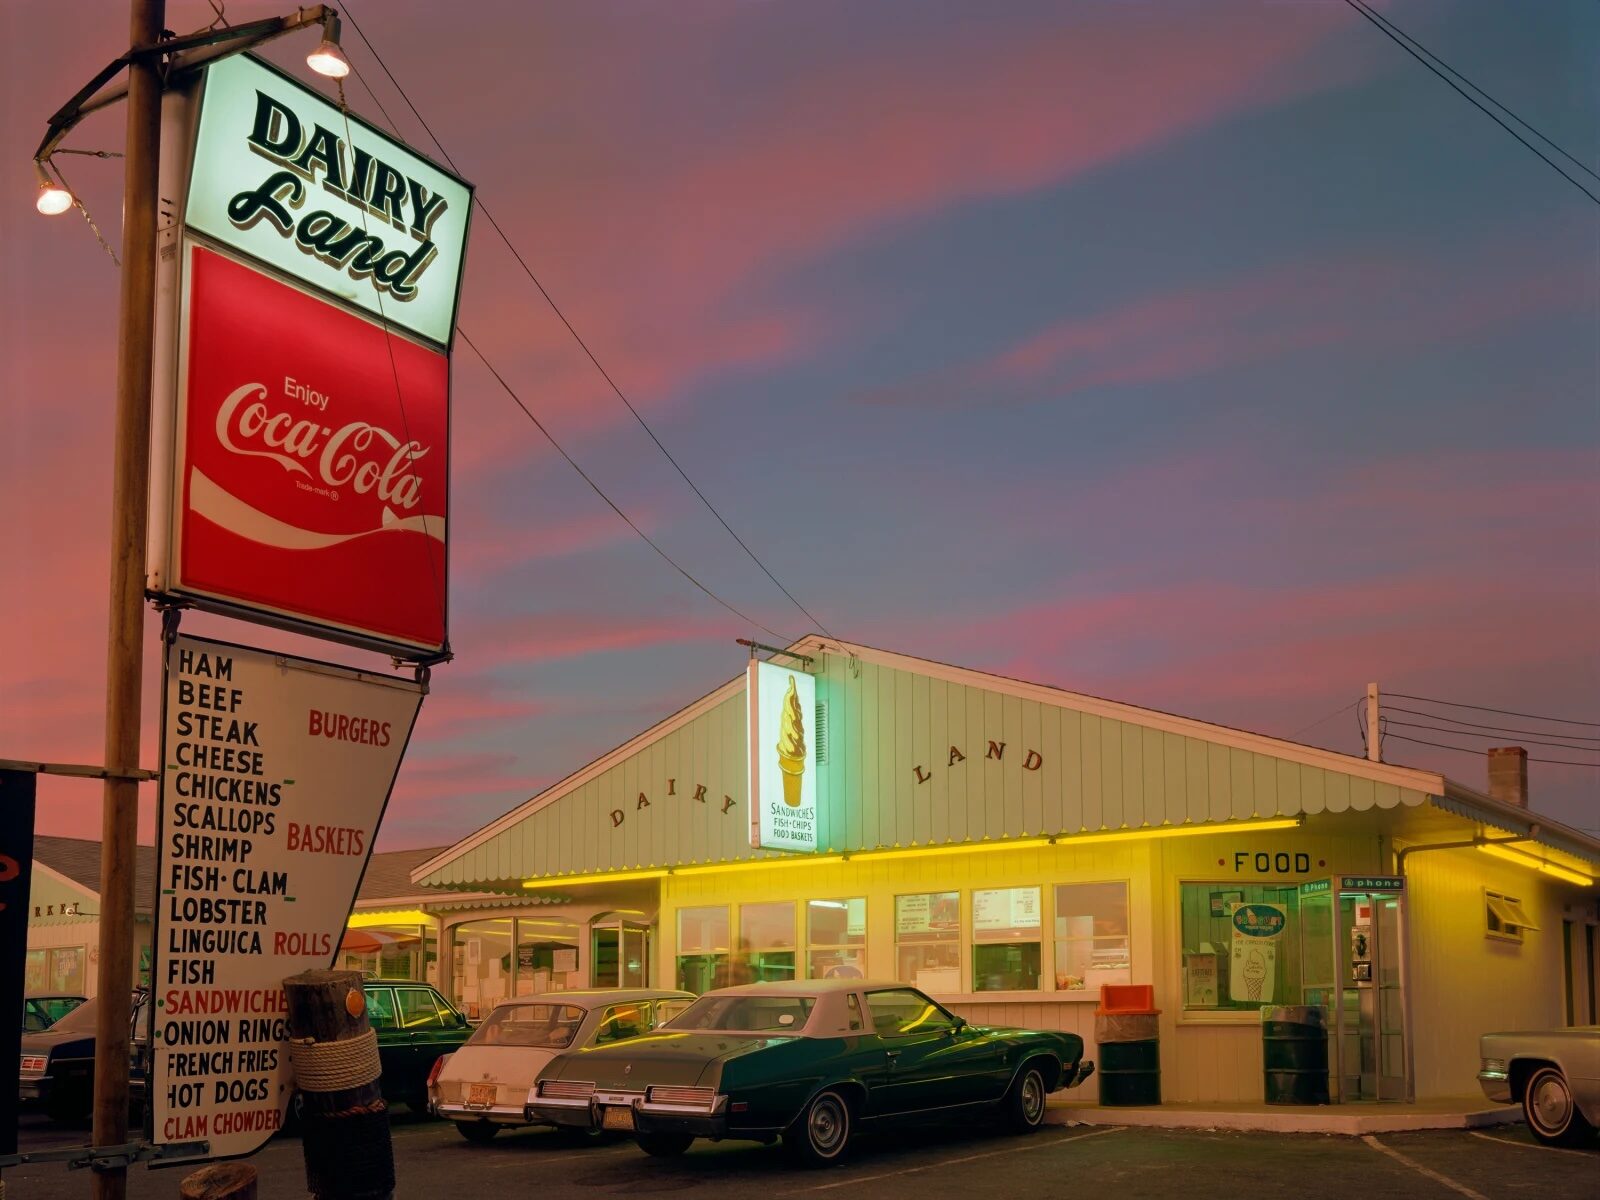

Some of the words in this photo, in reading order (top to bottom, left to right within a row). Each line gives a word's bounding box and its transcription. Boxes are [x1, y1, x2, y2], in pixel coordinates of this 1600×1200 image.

[247, 89, 448, 242] DAIRY
[228, 171, 438, 302] Land
[284, 376, 329, 410] Enjoy
[215, 382, 430, 509] Coca-Cola
[179, 649, 232, 681] HAM
[178, 679, 243, 713] BEEF
[176, 711, 259, 746] STEAK
[308, 710, 391, 747] BURGERS
[176, 742, 264, 775] CHEESE
[913, 740, 1043, 784] LAND
[175, 772, 281, 806] CHICKENS
[610, 779, 736, 827] DAIRY
[174, 803, 275, 835] SCALLOPS
[771, 802, 814, 820] SANDWICHES
[172, 833, 252, 863] SHRIMP
[287, 822, 364, 856] BASKETS
[1234, 852, 1310, 874] FOOD
[233, 868, 288, 895] CLAM
[1357, 879, 1401, 888] phone
[170, 897, 267, 925] LOBSTER
[169, 928, 262, 954] LINGUICA
[273, 932, 331, 955] ROLLS
[168, 959, 215, 984] FISH
[165, 989, 289, 1015] SANDWICHE
[164, 1020, 230, 1046] ONION
[238, 1017, 291, 1043] RINGS
[168, 1052, 233, 1077] FRENCH
[238, 1048, 278, 1073] FRIES
[168, 1083, 204, 1108] HOT
[215, 1078, 269, 1104] DOGS
[164, 1115, 208, 1140] CLAM
[213, 1108, 281, 1135] CHOWDER
